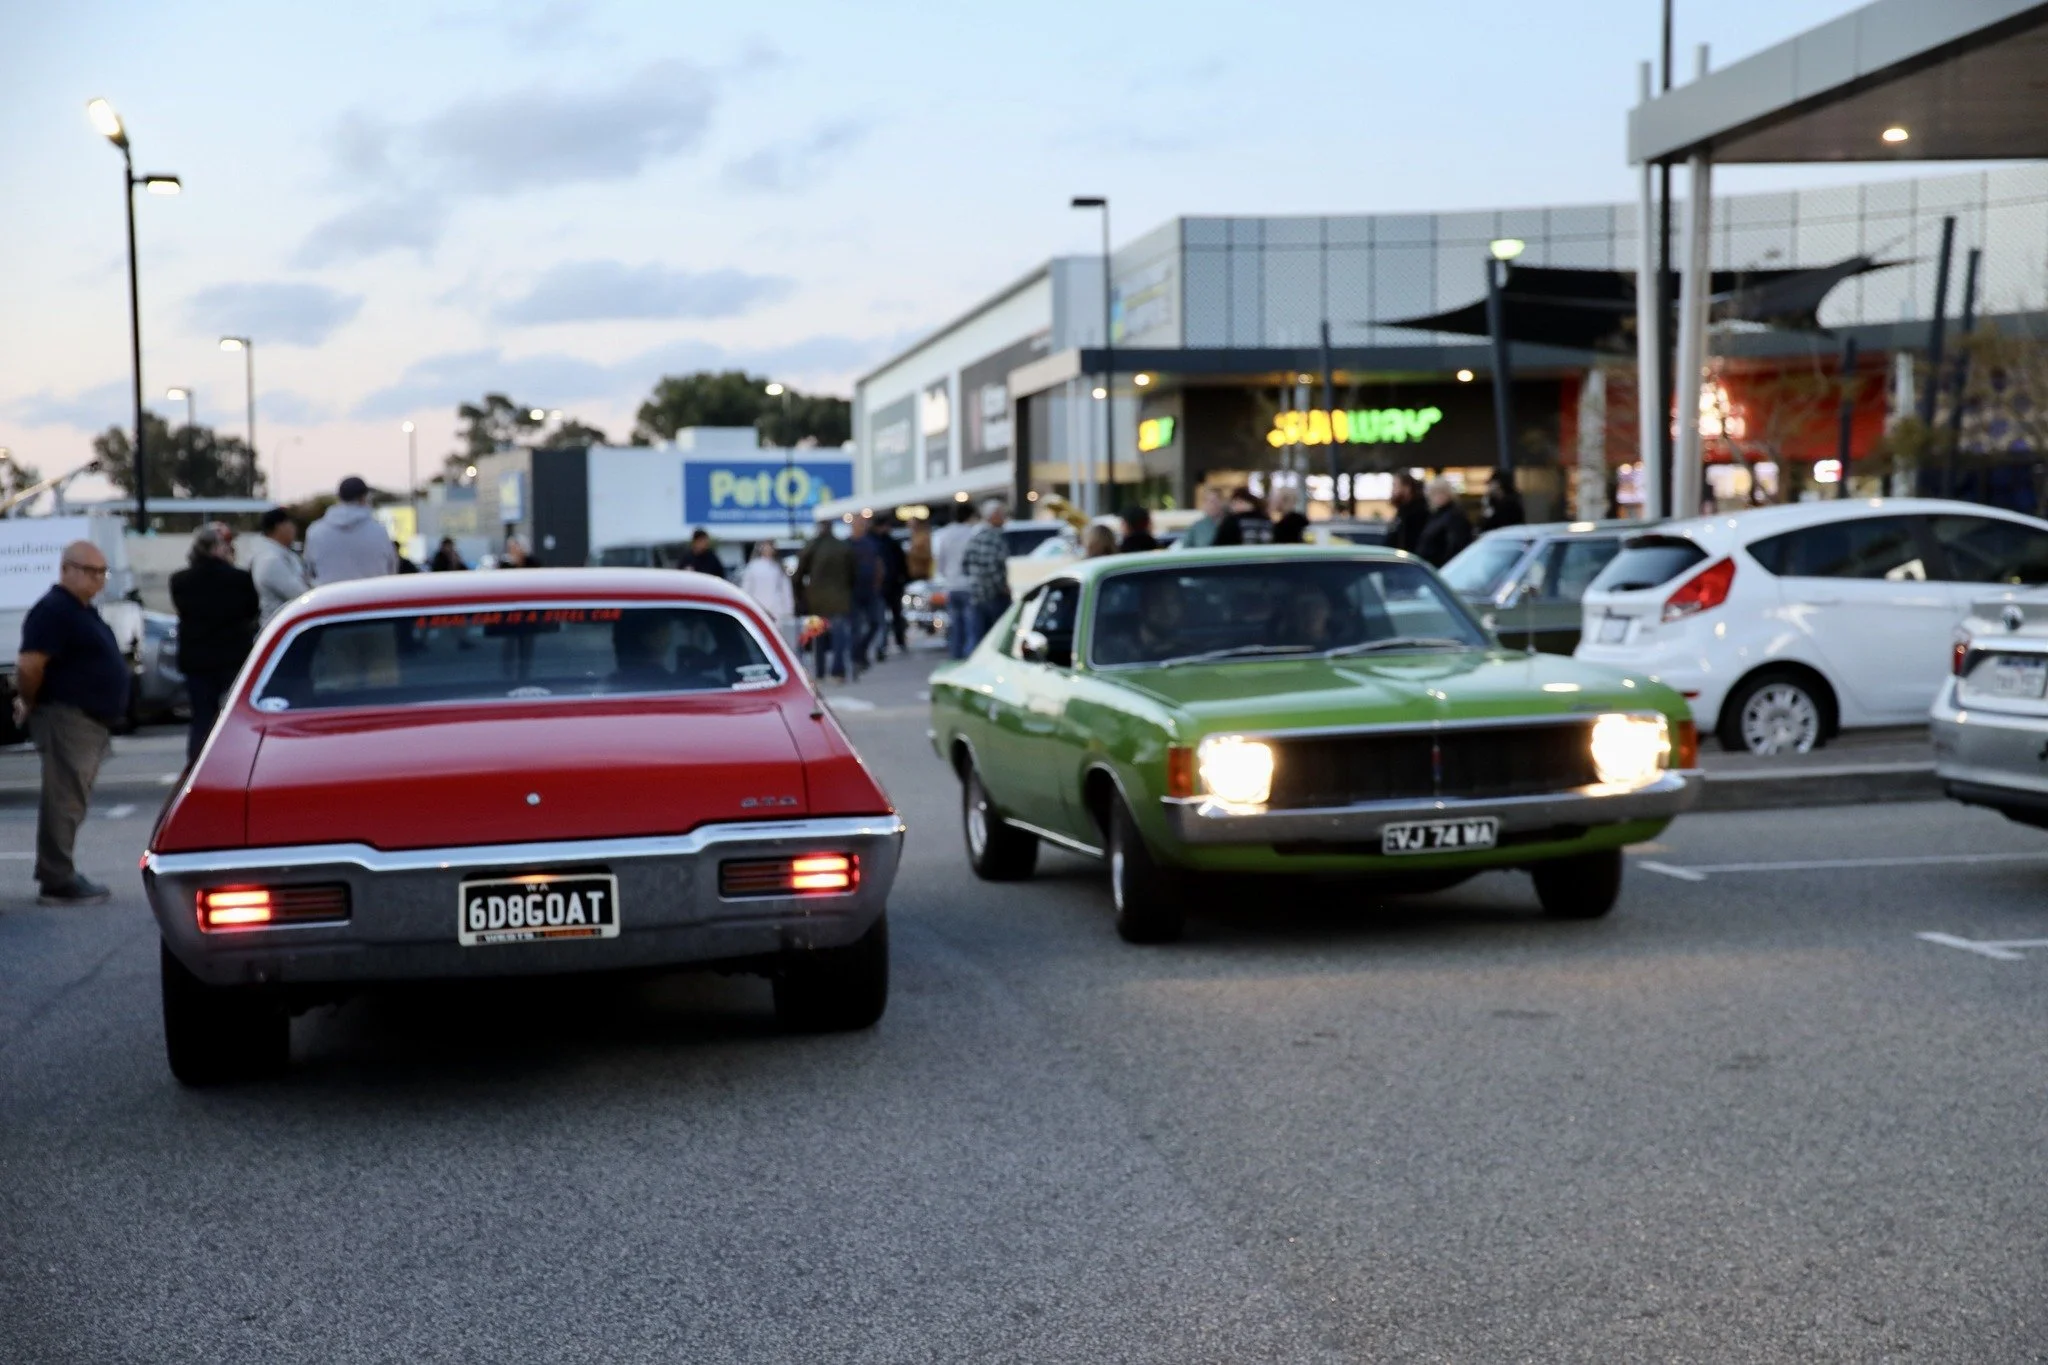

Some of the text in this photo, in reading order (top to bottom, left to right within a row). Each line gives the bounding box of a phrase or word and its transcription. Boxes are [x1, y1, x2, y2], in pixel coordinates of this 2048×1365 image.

[1396, 827, 1426, 850] VJ
[1430, 824, 1460, 848] 74
[1463, 822, 1492, 844] WA
[469, 891, 604, 930] 6D8GOAT
